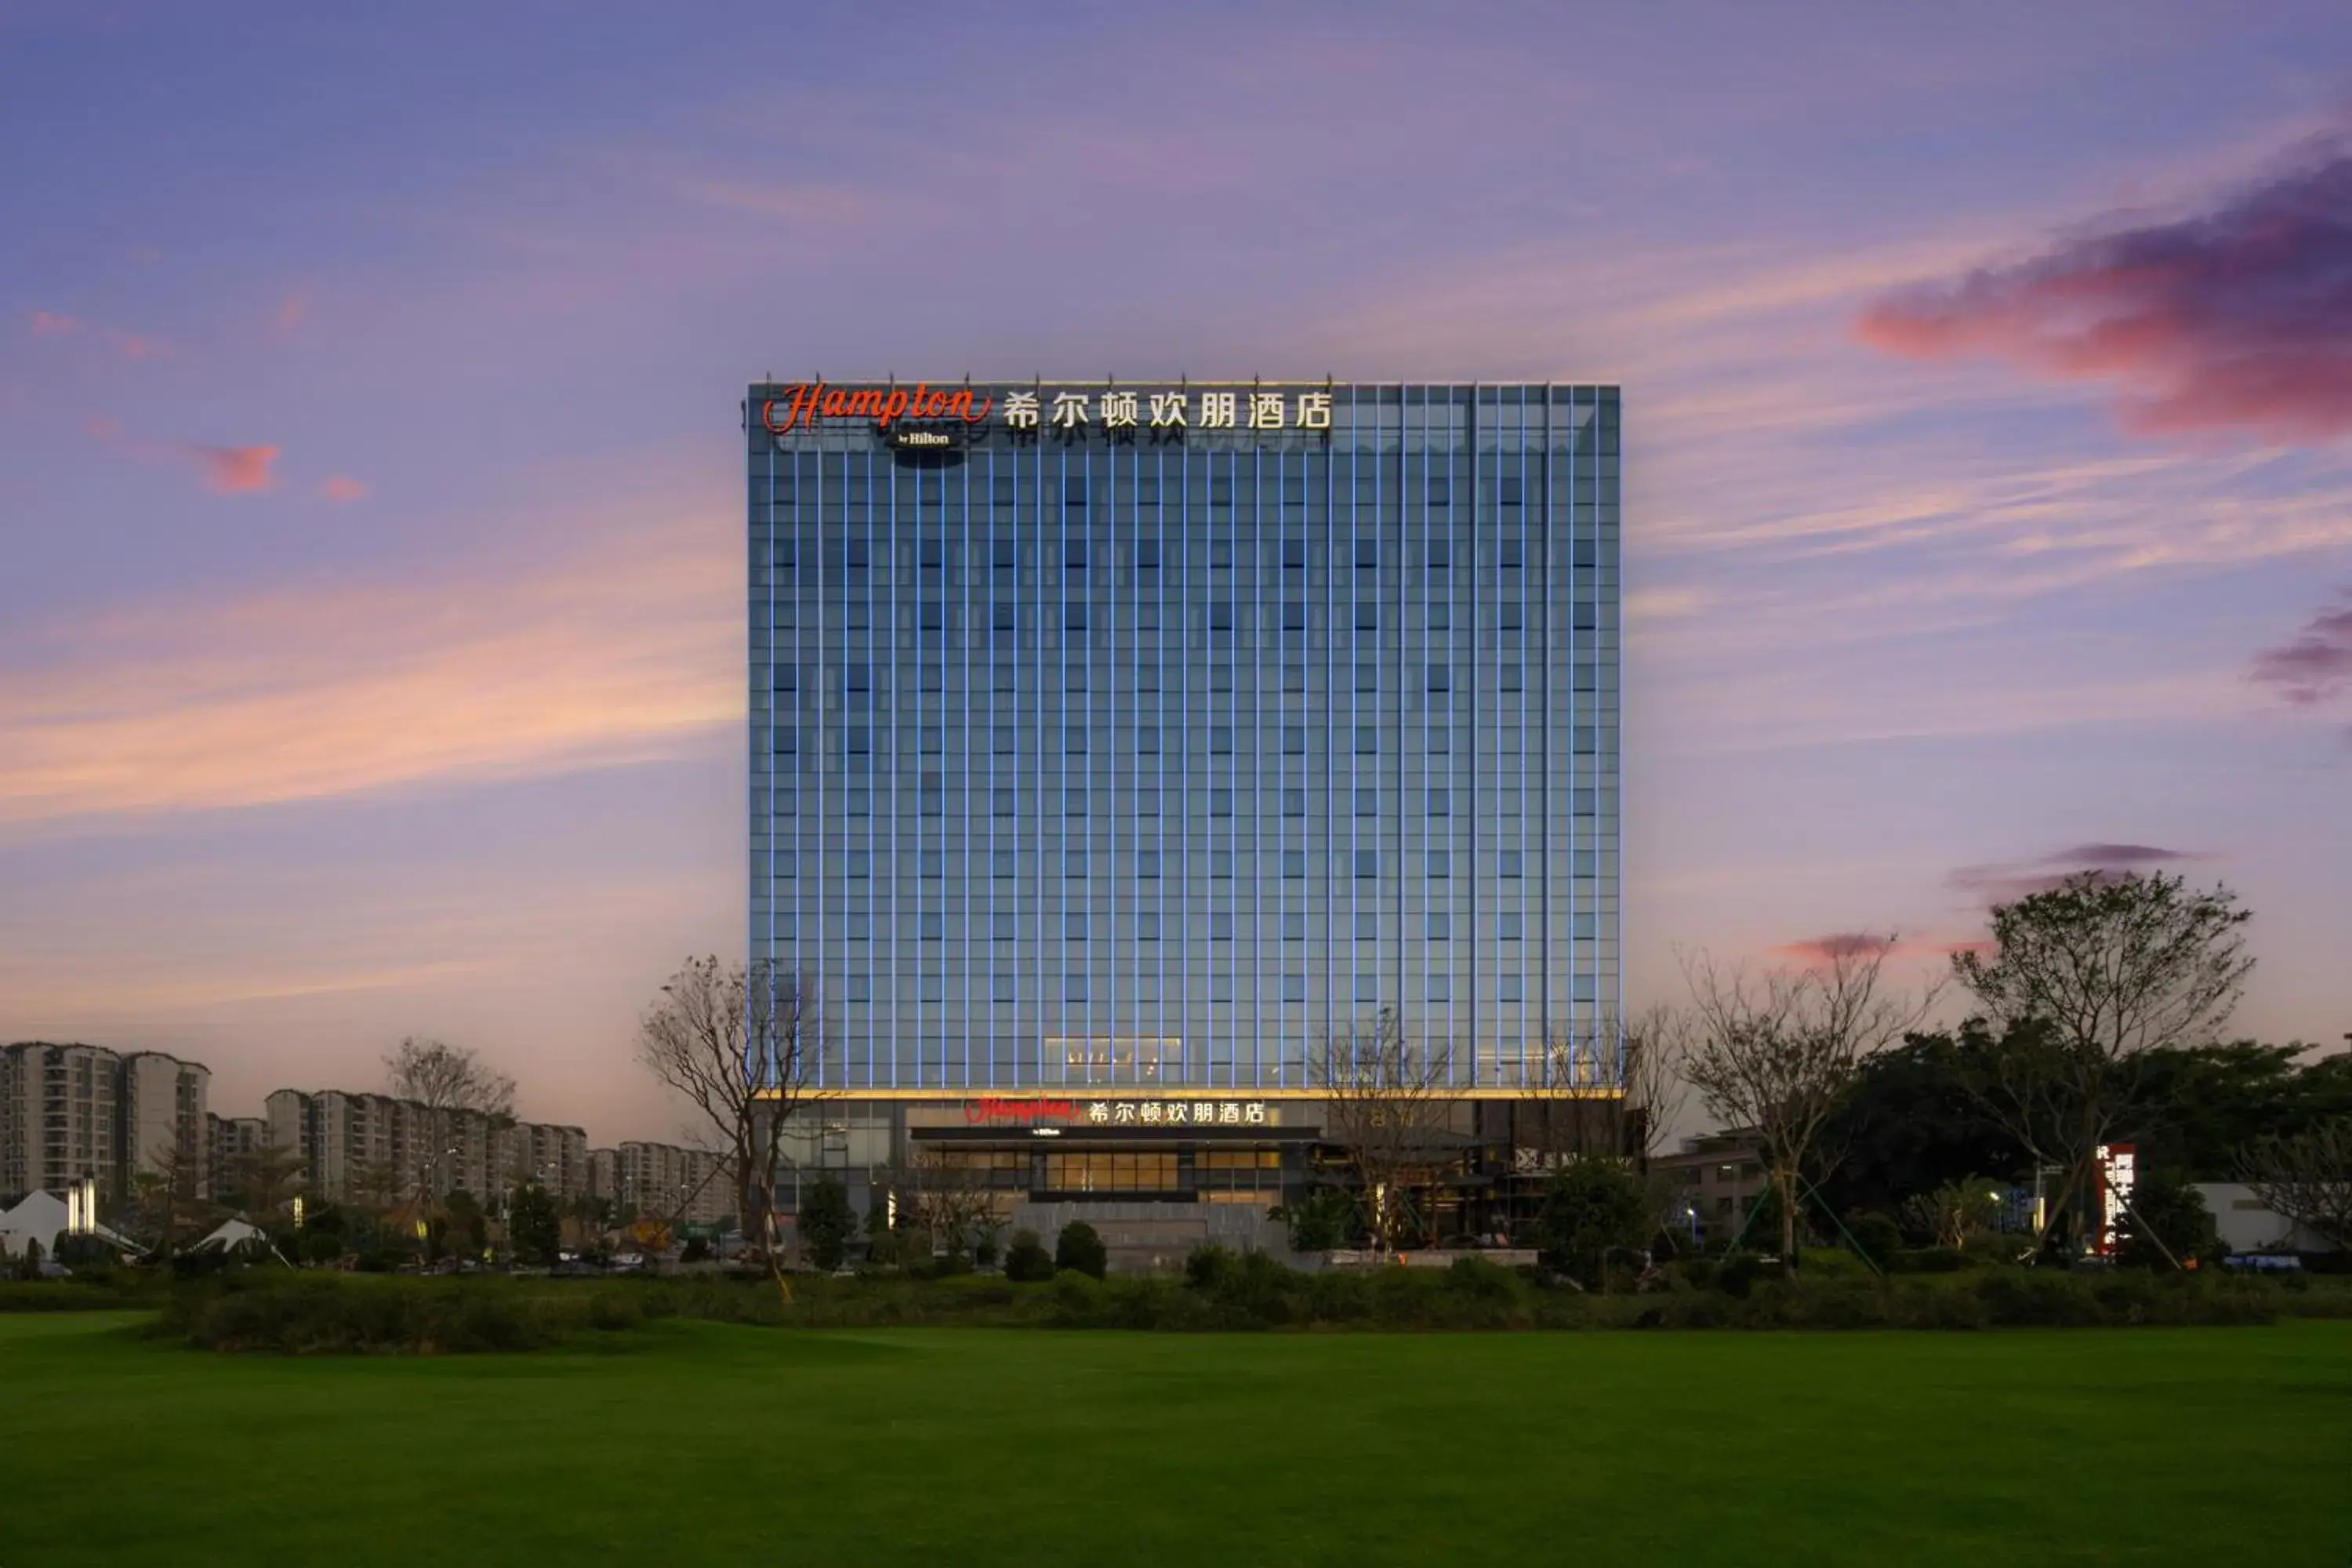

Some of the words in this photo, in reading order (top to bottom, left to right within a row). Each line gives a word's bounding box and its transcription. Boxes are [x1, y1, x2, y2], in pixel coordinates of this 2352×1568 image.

[763, 382, 993, 433] Hampton
[1003, 390, 1332, 429] 希尔顿欢朋酒店
[909, 432, 949, 445] Hilton
[1089, 1102, 1265, 1123] 希尔顿欢朋酒店
